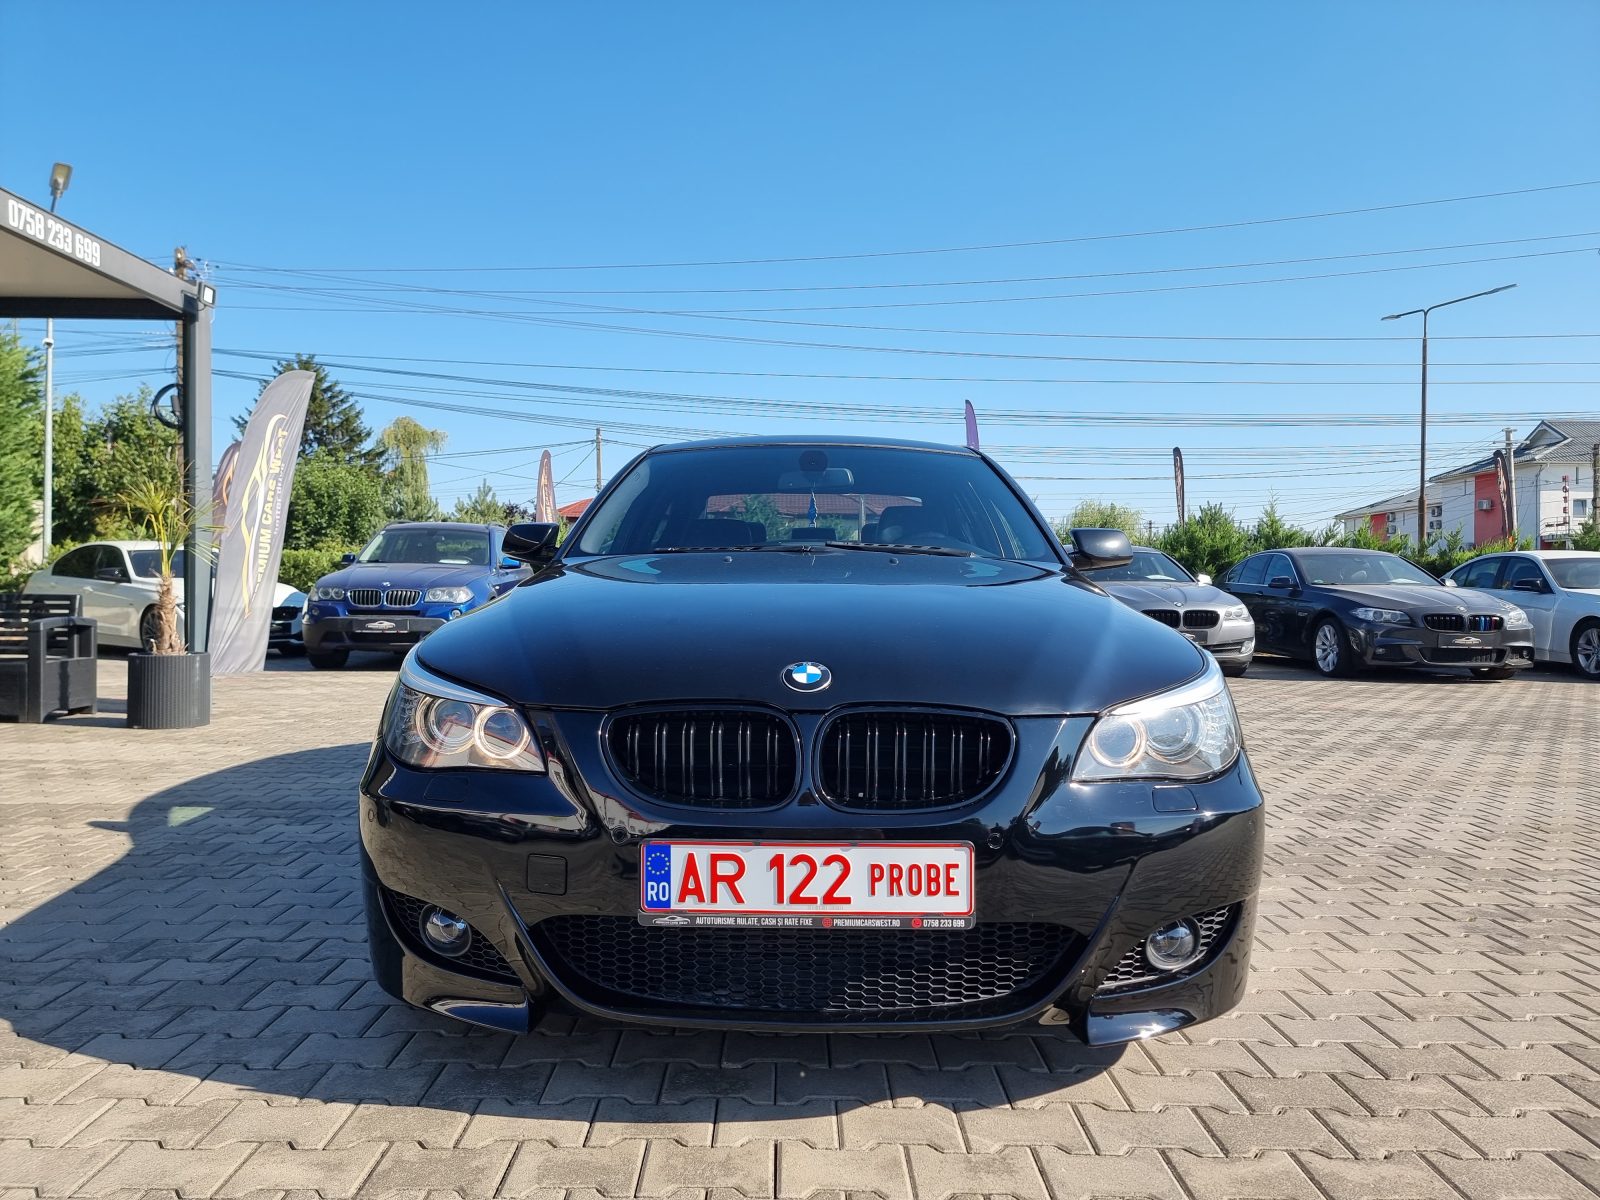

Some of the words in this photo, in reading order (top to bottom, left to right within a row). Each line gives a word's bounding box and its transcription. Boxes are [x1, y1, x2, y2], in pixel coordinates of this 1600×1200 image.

[8, 199, 44, 240] 0758
[47, 218, 73, 253] 233
[75, 233, 101, 267] 699
[252, 528, 272, 602] EMIUM
[677, 852, 746, 904] AR
[769, 853, 852, 905] 122
[869, 863, 960, 897] PROBE
[647, 881, 669, 902] RO
[695, 916, 737, 925] AUTOTURISME
[737, 916, 760, 926] RULATE,
[761, 917, 777, 925] CASH
[784, 917, 799, 926] RATE
[800, 917, 813, 926] FIXE
[833, 918, 901, 928] PREMIUMCARSWEST.RO
[923, 919, 939, 928] 0758
[939, 919, 952, 928] 233
[952, 919, 965, 928] 699
